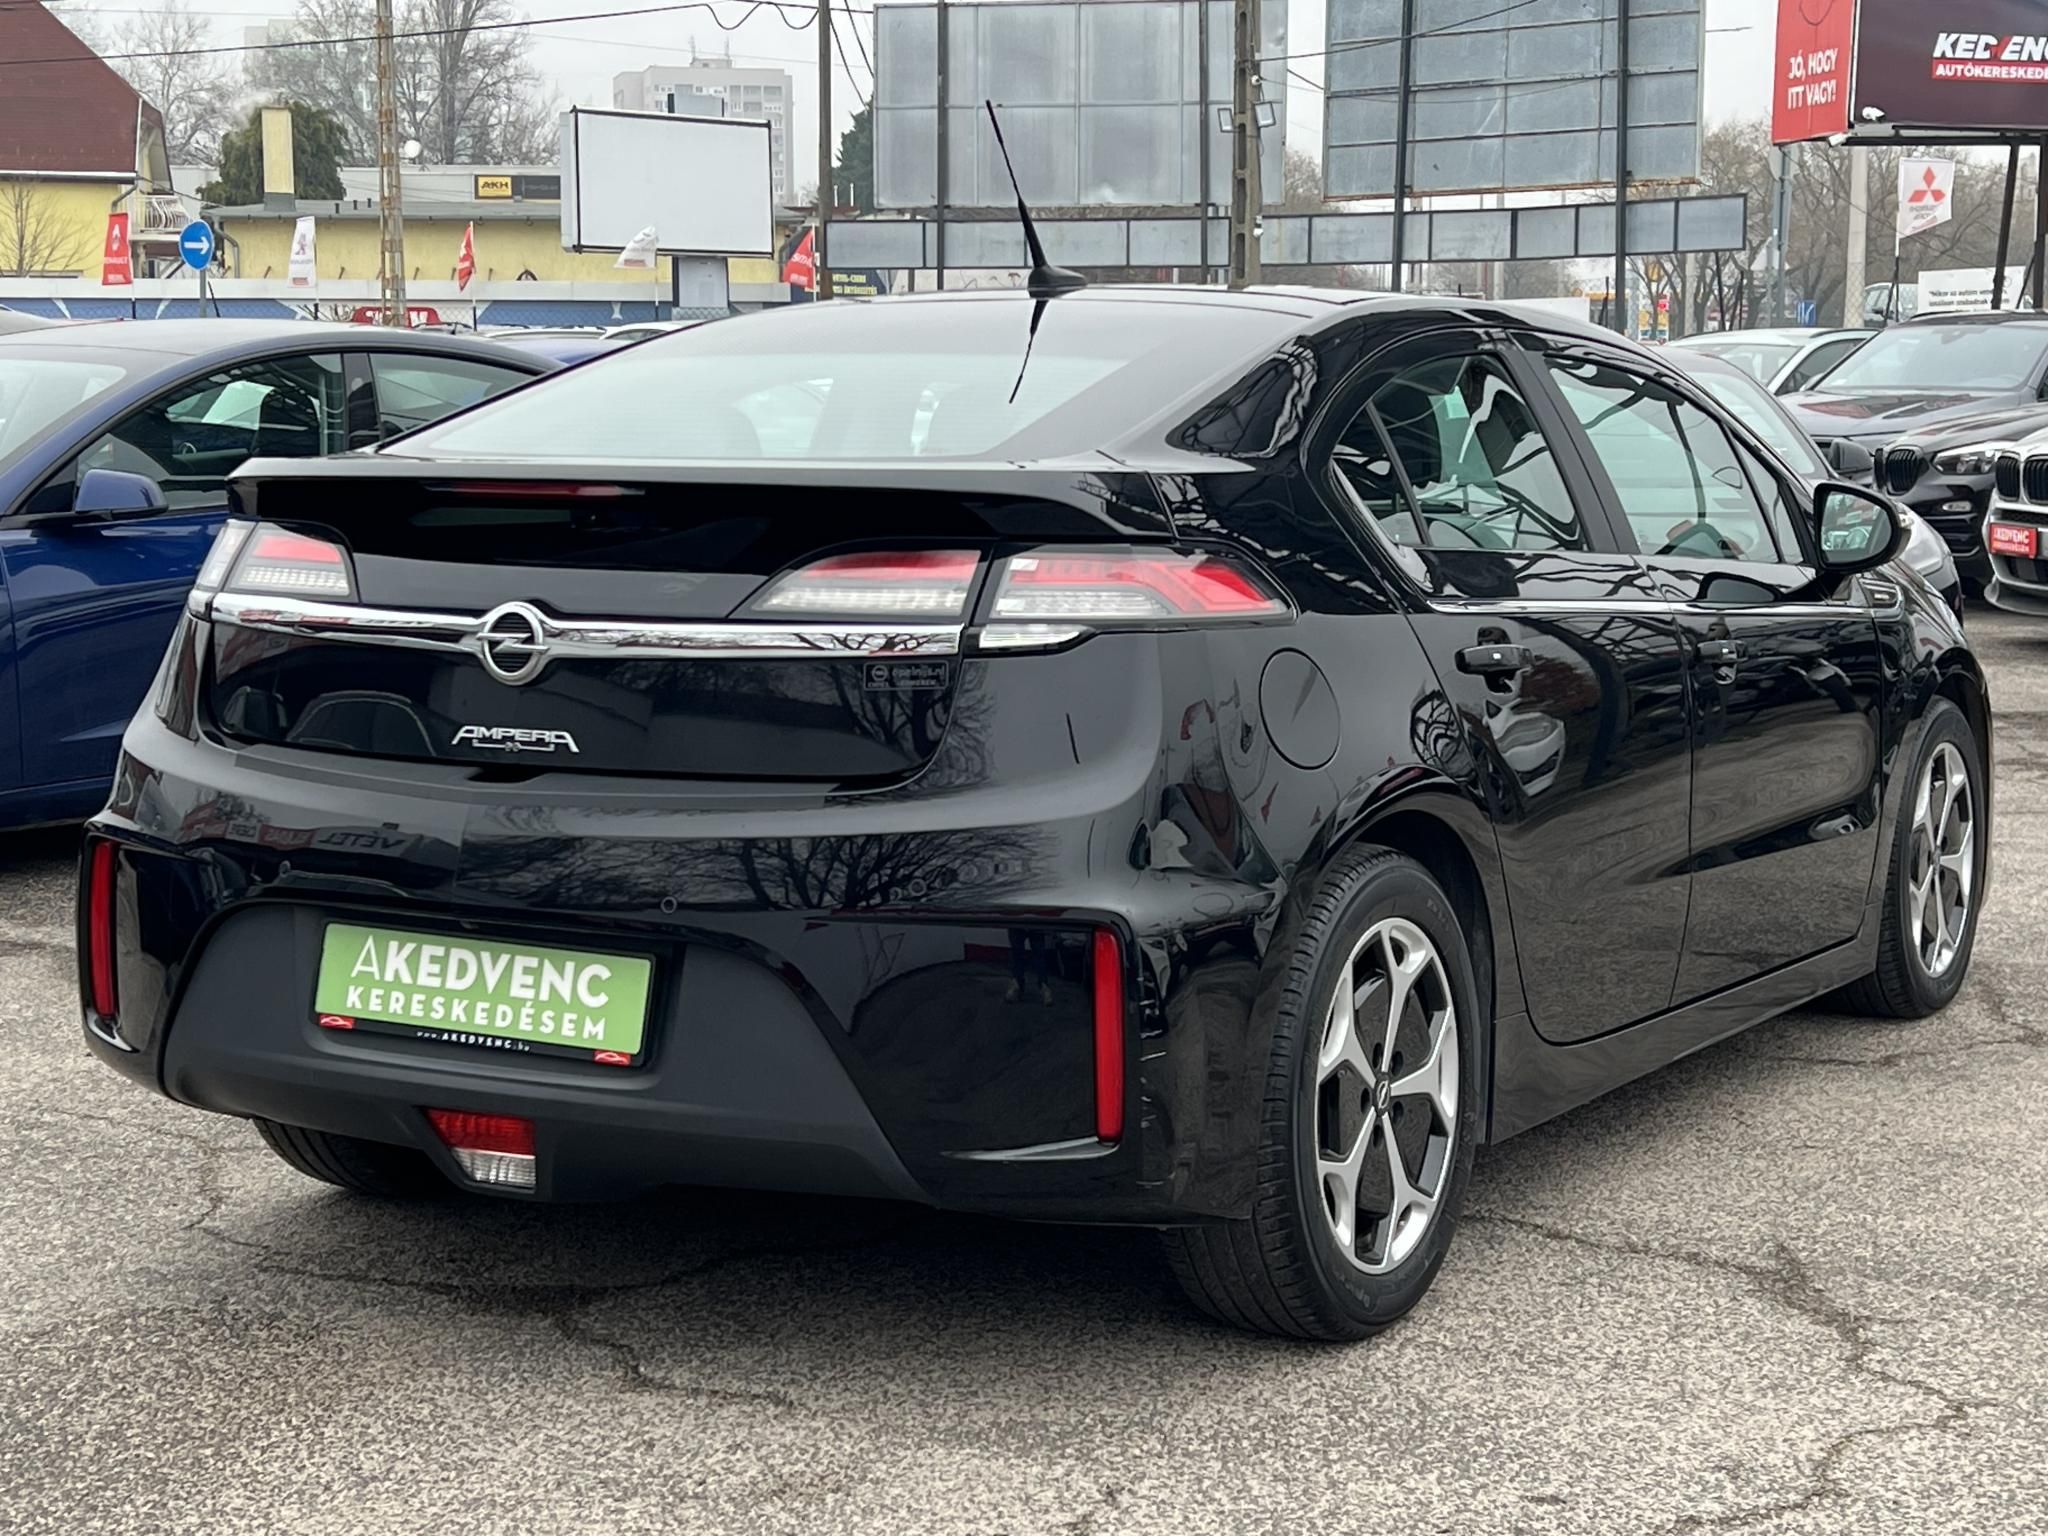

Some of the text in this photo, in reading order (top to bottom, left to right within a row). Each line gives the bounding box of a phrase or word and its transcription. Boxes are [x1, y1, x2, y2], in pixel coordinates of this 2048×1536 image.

[1788, 48, 1838, 81] JÓ, HOGY
[1787, 79, 1837, 110] ITT VAGY!
[451, 725, 580, 753] AMPERA
[351, 935, 612, 1008] AKEDVENC
[346, 985, 606, 1041] KERESKEDÉSEM
